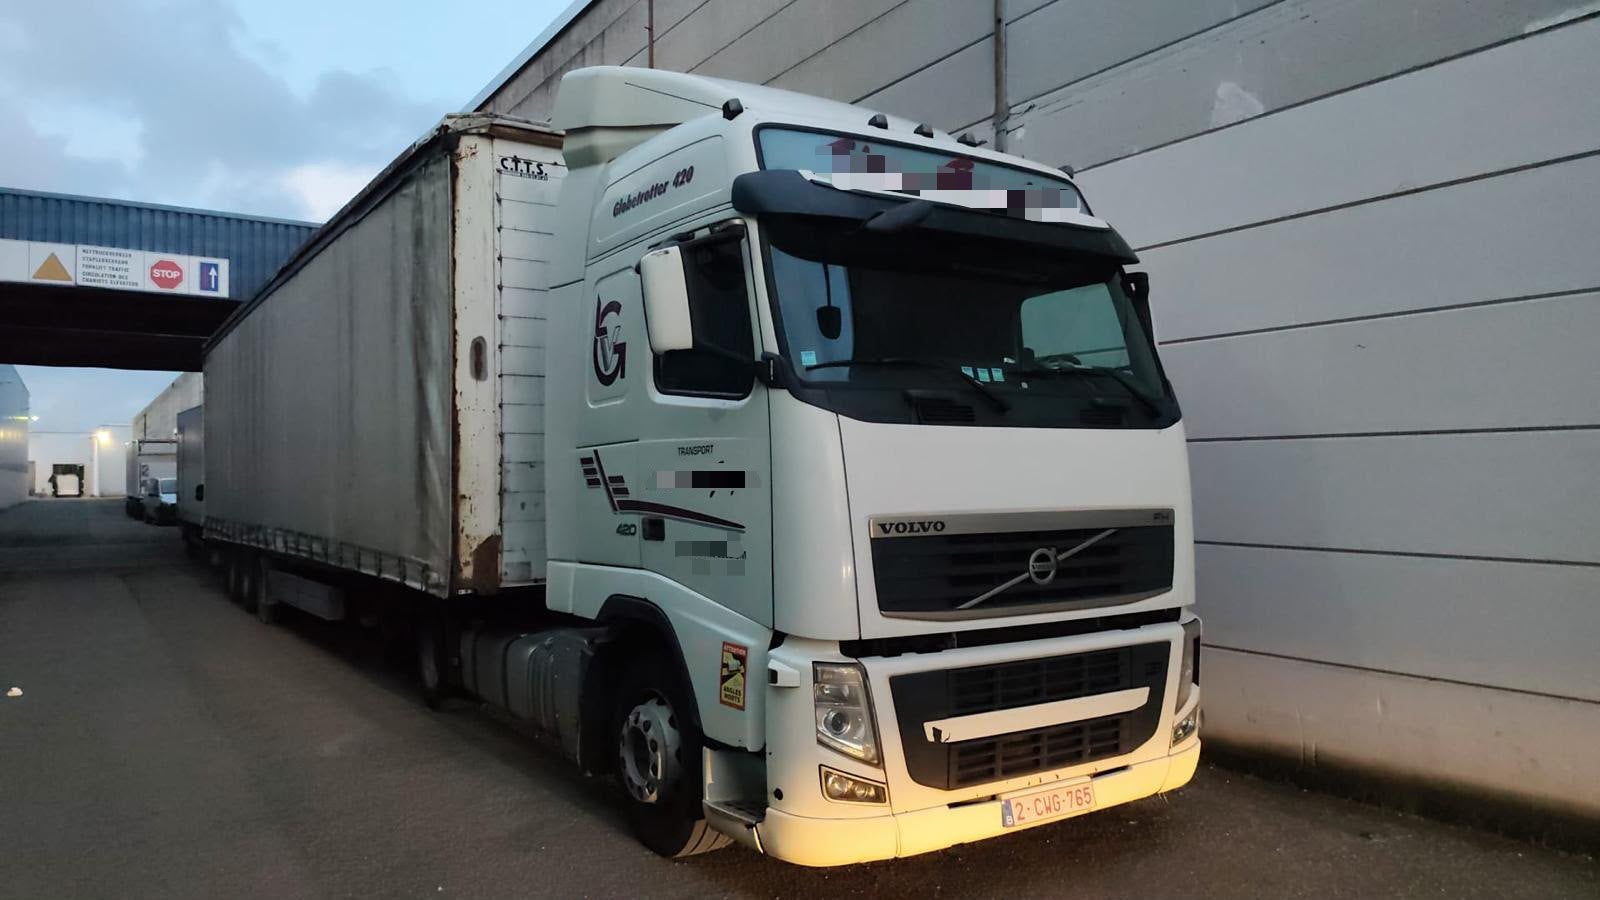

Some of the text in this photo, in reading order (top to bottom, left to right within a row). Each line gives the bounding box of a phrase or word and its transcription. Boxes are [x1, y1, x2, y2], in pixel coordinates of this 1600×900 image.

[613, 165, 694, 218] Globetrotter 420
[153, 268, 181, 280] STOP
[678, 445, 714, 456] TRANSPORT
[616, 523, 637, 536] 420
[878, 520, 946, 534] VOLVO
